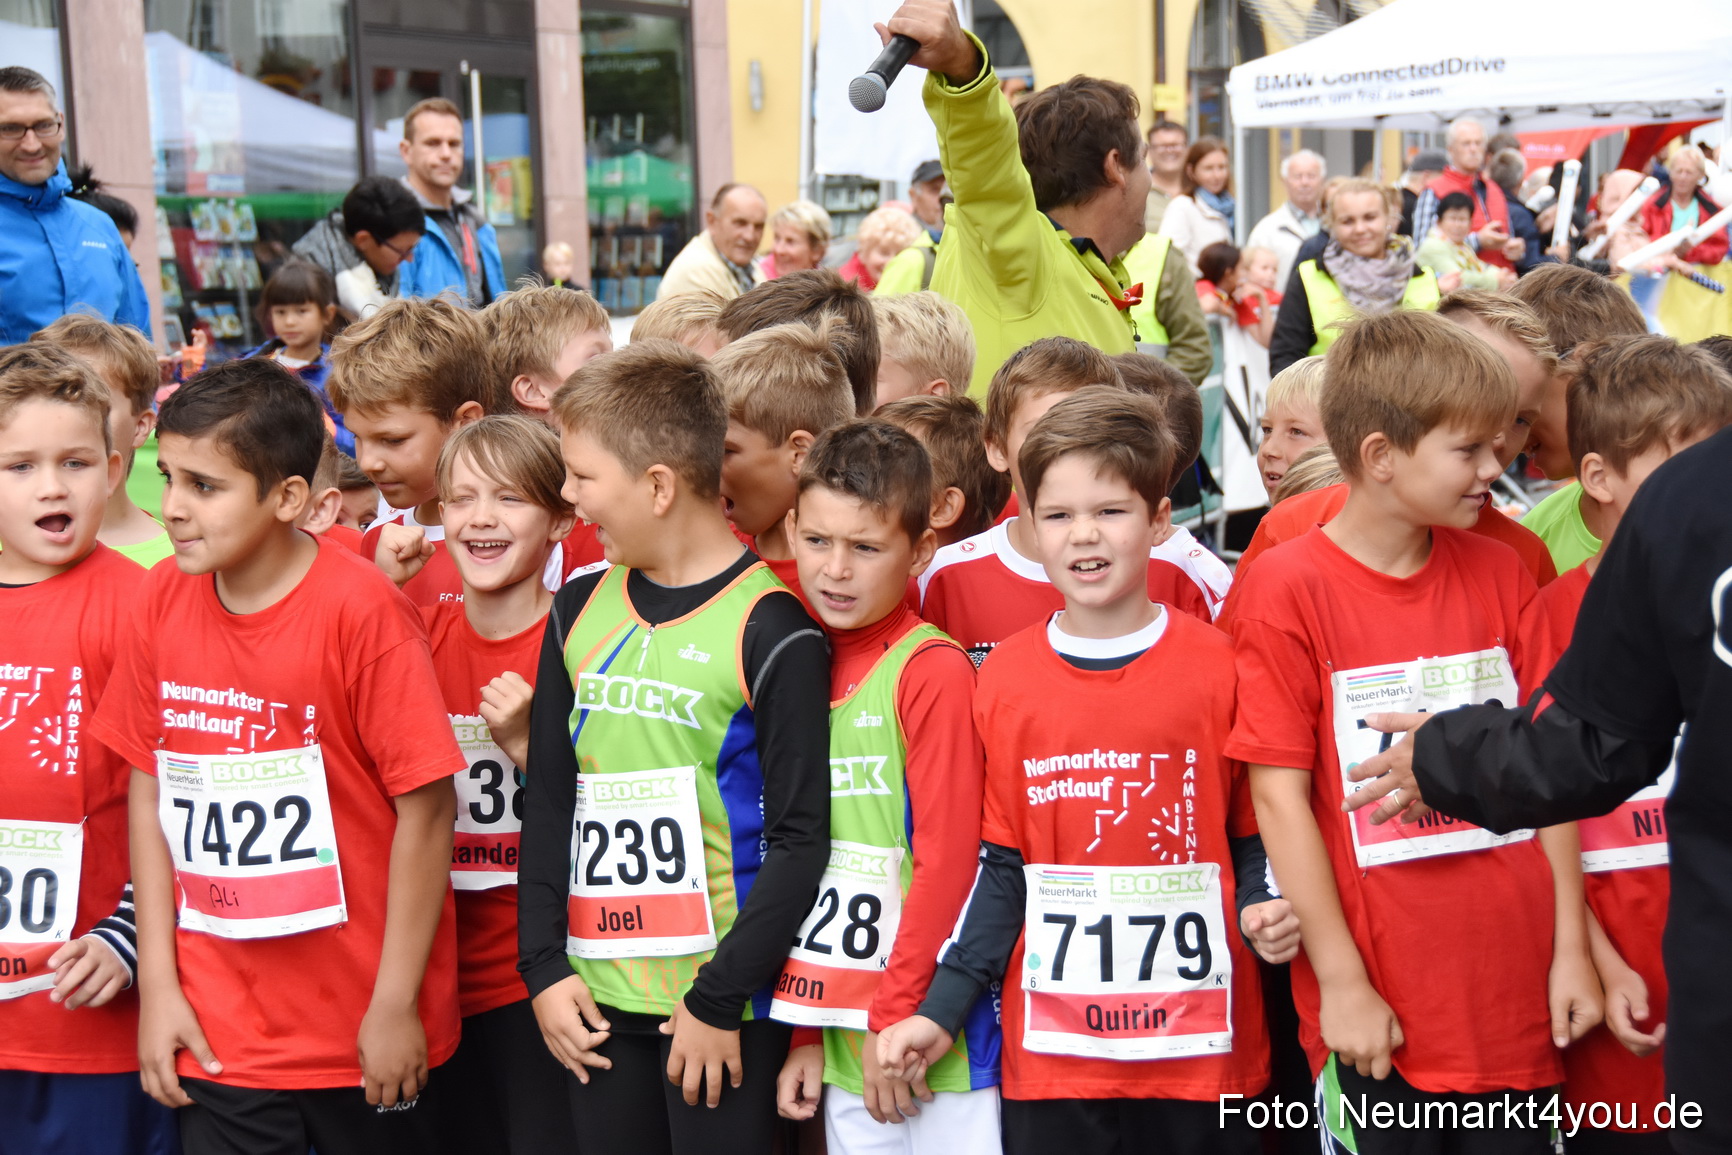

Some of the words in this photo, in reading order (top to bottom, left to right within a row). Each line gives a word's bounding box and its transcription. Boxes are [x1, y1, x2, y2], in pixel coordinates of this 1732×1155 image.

[1255, 73, 1312, 92] BMW
[1322, 56, 1506, 86] ConnectedDrive
[1345, 686, 1413, 703] NeuerMarkt
[1421, 656, 1503, 689] BOCK
[162, 681, 265, 713] Neumarkter
[574, 672, 704, 730] BOCK
[66, 666, 83, 775] BAMBINI
[163, 708, 245, 740] Sadtlauf
[166, 772, 204, 786] NeuerMarkt
[210, 754, 307, 783] BOCK
[213, 783, 239, 792] inspired
[240, 783, 249, 792] by
[251, 782, 273, 790] smart
[274, 777, 310, 788] concepts
[593, 776, 679, 802] BOCK
[1183, 749, 1197, 864] BAMBINI
[173, 795, 318, 866] 7422
[827, 847, 889, 876] BOCK
[209, 884, 240, 908] Ali
[691, 878, 699, 889] K
[1038, 886, 1098, 898] NeuerMarkt
[1110, 870, 1206, 895] BOCK
[1110, 896, 1141, 905] inspired
[1143, 896, 1152, 904] by
[1154, 895, 1175, 903] smart
[1177, 894, 1206, 903] concepts
[597, 905, 643, 932] Joel
[1043, 911, 1212, 982] 7179
[879, 957, 887, 969] K
[1030, 977, 1036, 988] 6
[1216, 974, 1224, 985] K
[1085, 1003, 1167, 1032] Quirin
